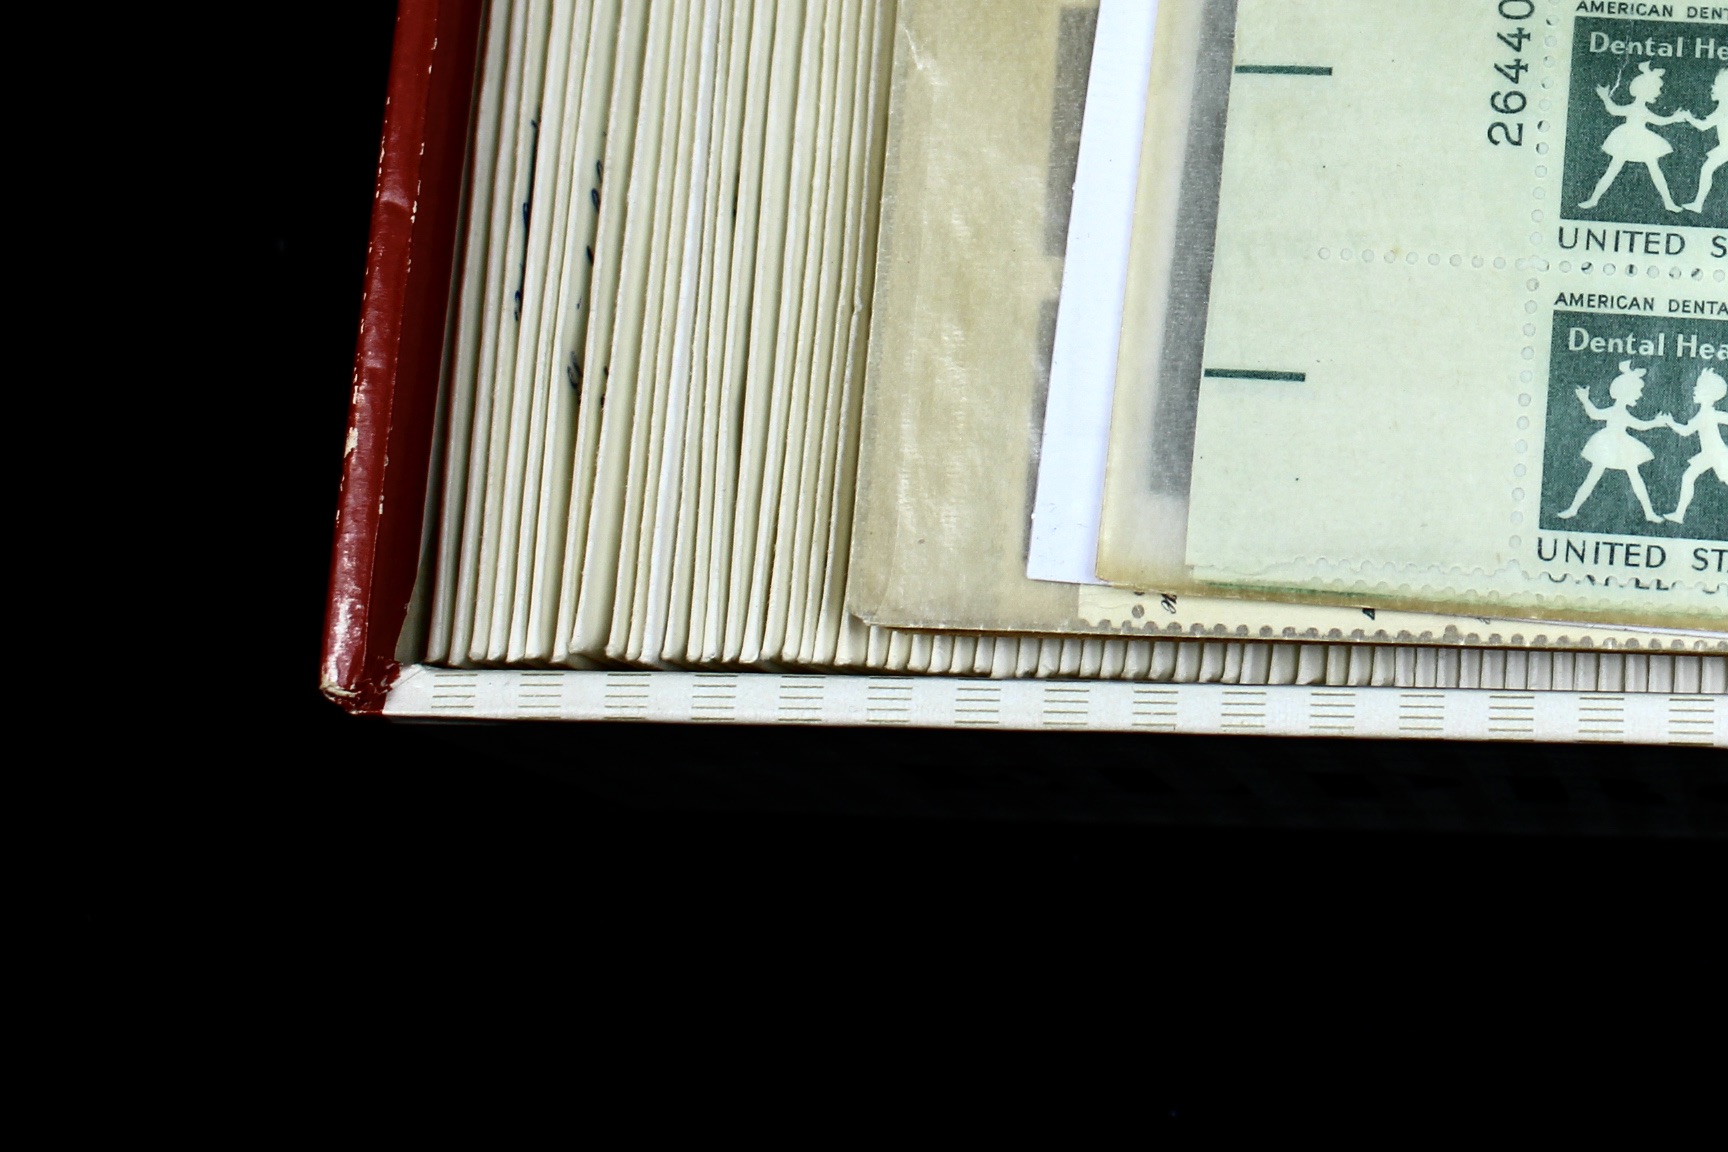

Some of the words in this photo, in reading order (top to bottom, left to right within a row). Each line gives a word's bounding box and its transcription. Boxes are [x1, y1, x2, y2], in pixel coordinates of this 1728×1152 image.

[1575, 0, 1674, 18] AMERICAN
[1588, 30, 1684, 59] Dental
[1558, 226, 1686, 256] UNITED
[1554, 291, 1655, 312] AMERICAN
[1567, 326, 1665, 358] Dental
[1537, 537, 1667, 569] UNITED
